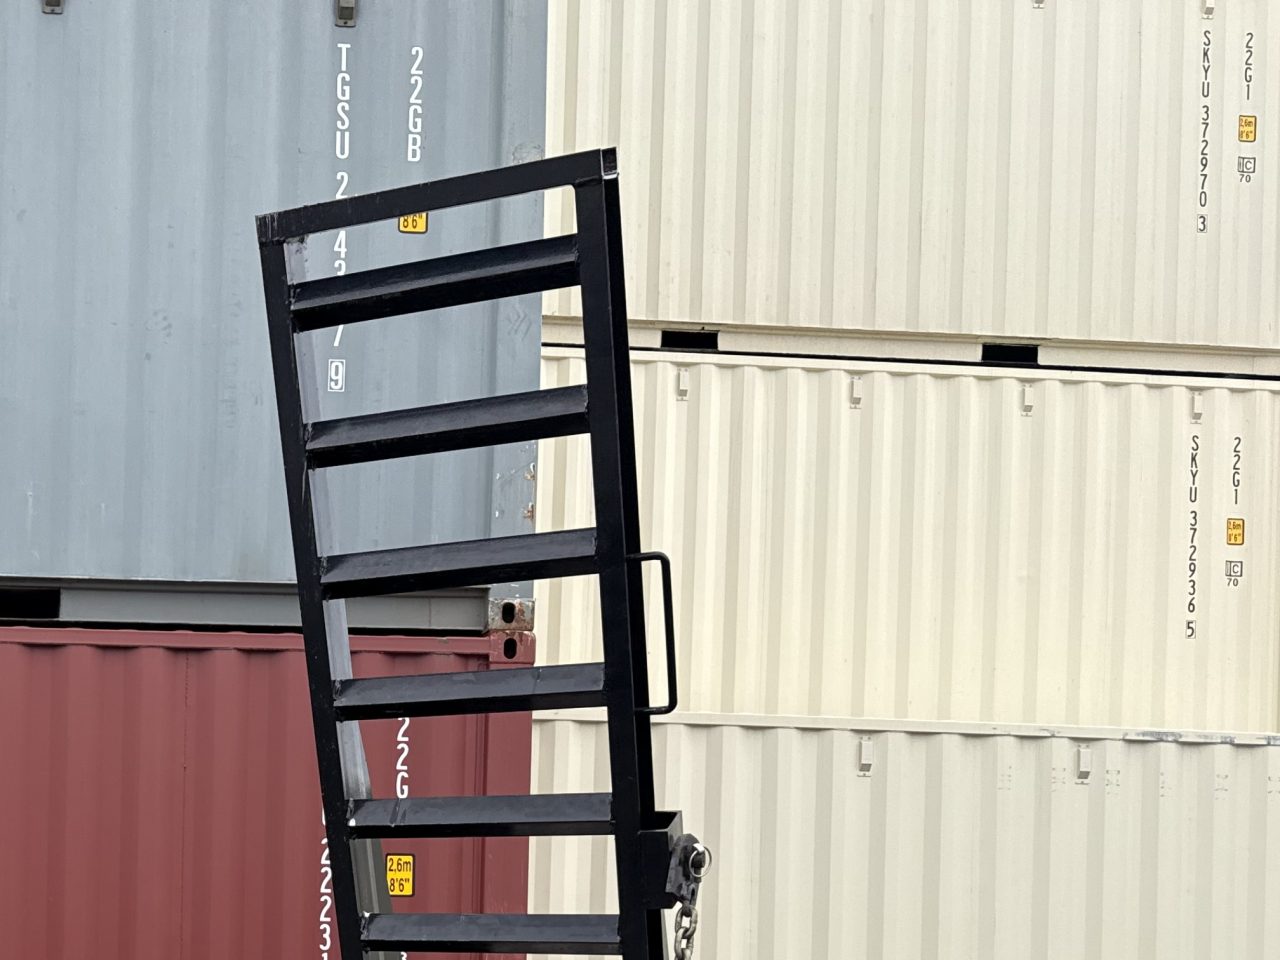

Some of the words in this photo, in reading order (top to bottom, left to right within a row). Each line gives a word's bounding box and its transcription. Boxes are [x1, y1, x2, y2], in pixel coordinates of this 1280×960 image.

[1202, 30, 1211, 98] SKYU
[1244, 32, 1254, 100] 22G1
[335, 43, 351, 160] TGSU
[406, 46, 424, 162] 22GB
[1199, 105, 1209, 207] 372970
[330, 362, 344, 391] 9
[1189, 435, 1199, 503] SKYU
[1232, 437, 1242, 504] 22G1
[1187, 511, 1198, 613] 372936
[395, 717, 410, 799] 22G
[388, 858, 412, 875] 2,6m
[389, 877, 410, 893] 8'6"
